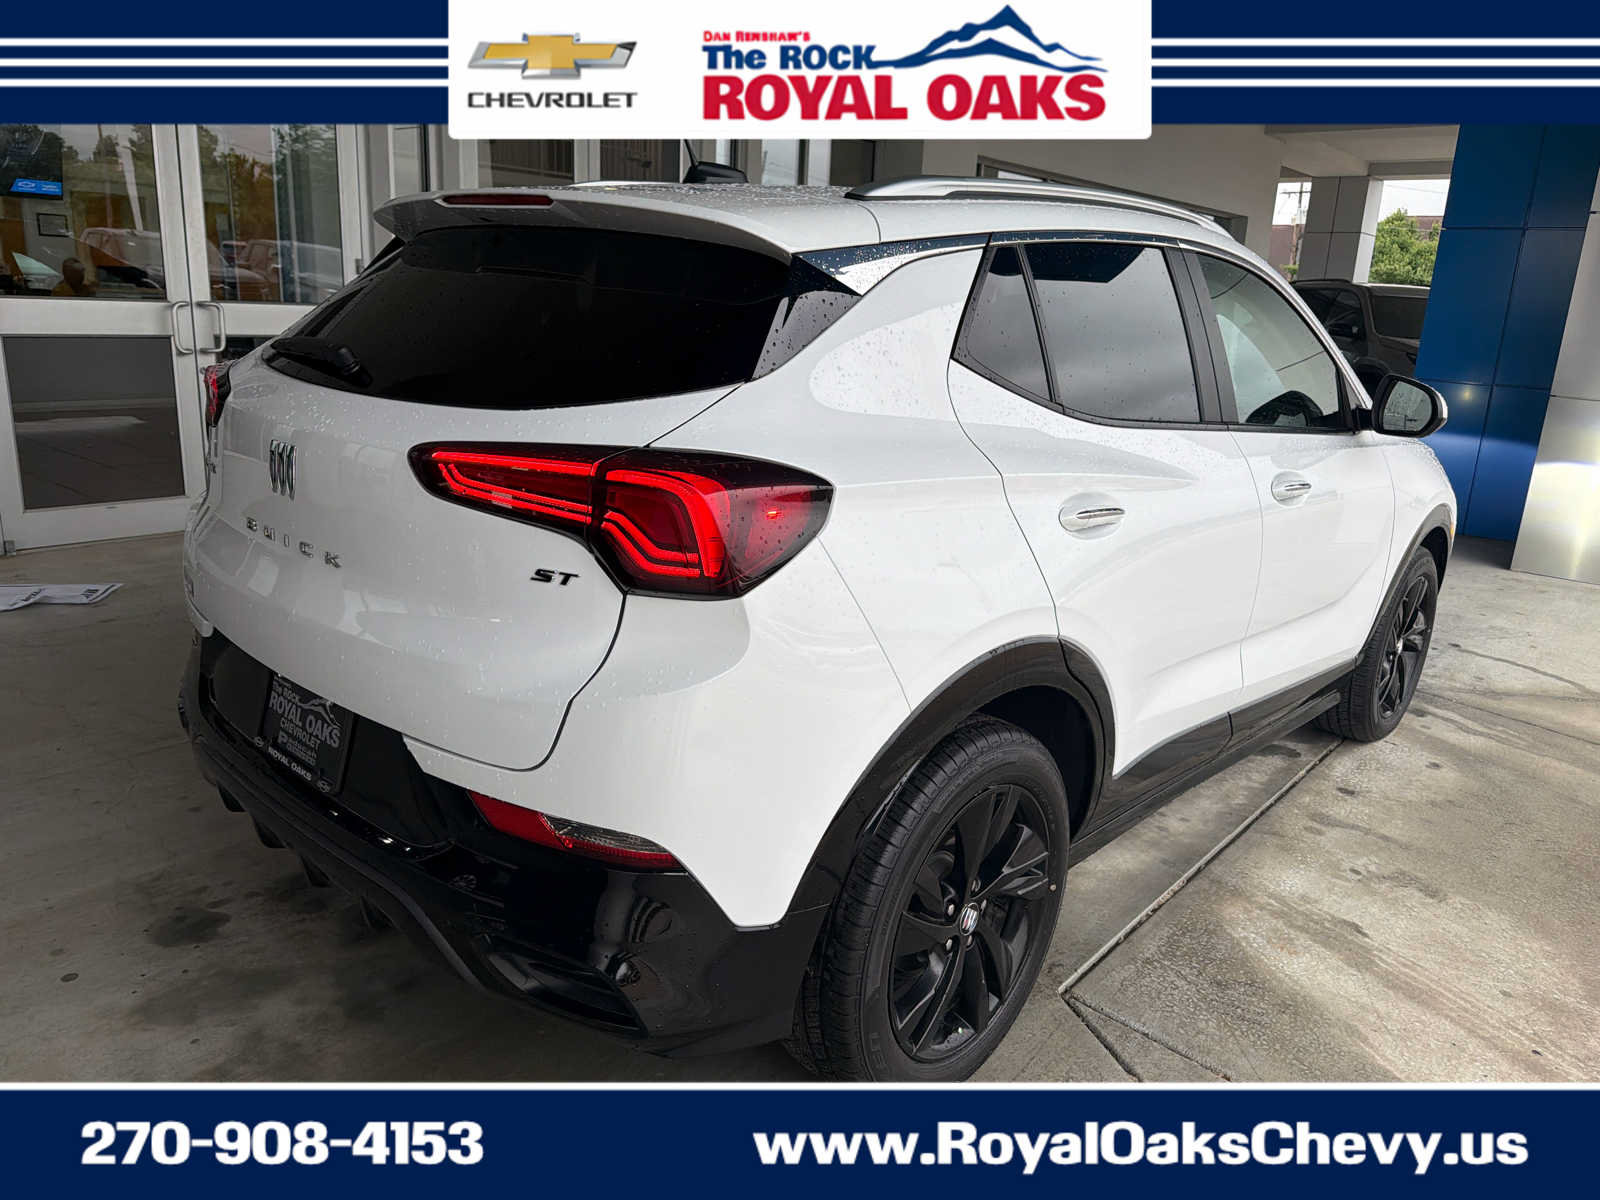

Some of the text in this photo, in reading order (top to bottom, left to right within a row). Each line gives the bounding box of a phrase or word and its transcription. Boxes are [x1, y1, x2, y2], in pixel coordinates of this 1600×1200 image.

[246, 516, 343, 569] BUICK
[530, 567, 580, 587] ST
[268, 690, 303, 728] ROYAL
[305, 714, 341, 749] OAKS
[279, 716, 321, 750] CHEVROLET
[267, 746, 290, 767] ROYAL
[290, 761, 313, 781] OAKS
